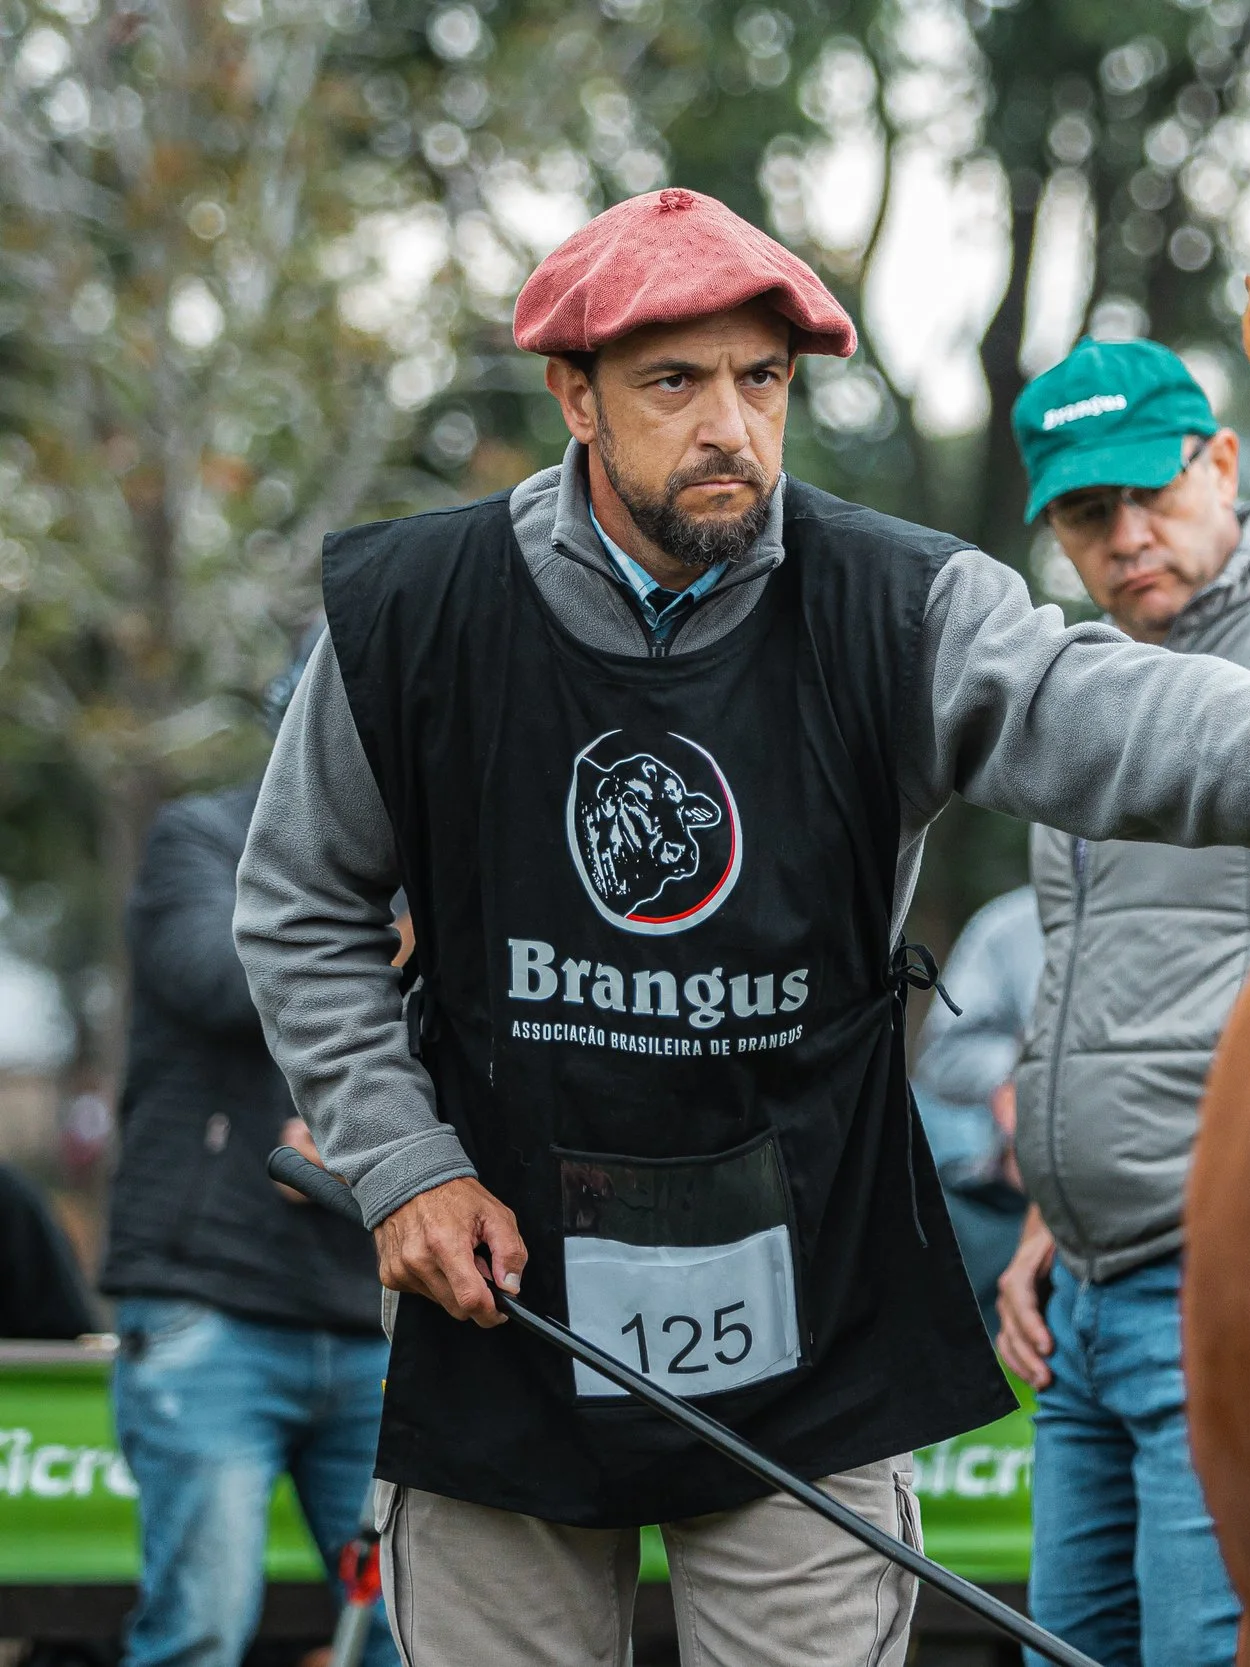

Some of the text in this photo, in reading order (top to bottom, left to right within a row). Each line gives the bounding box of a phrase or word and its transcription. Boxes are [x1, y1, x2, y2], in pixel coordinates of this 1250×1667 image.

[508, 938, 809, 1029] Brangus
[512, 1020, 804, 1056] ASSOCIAÇÃO BRASILEIRA DE BRANGUS
[621, 1300, 753, 1375] 125
